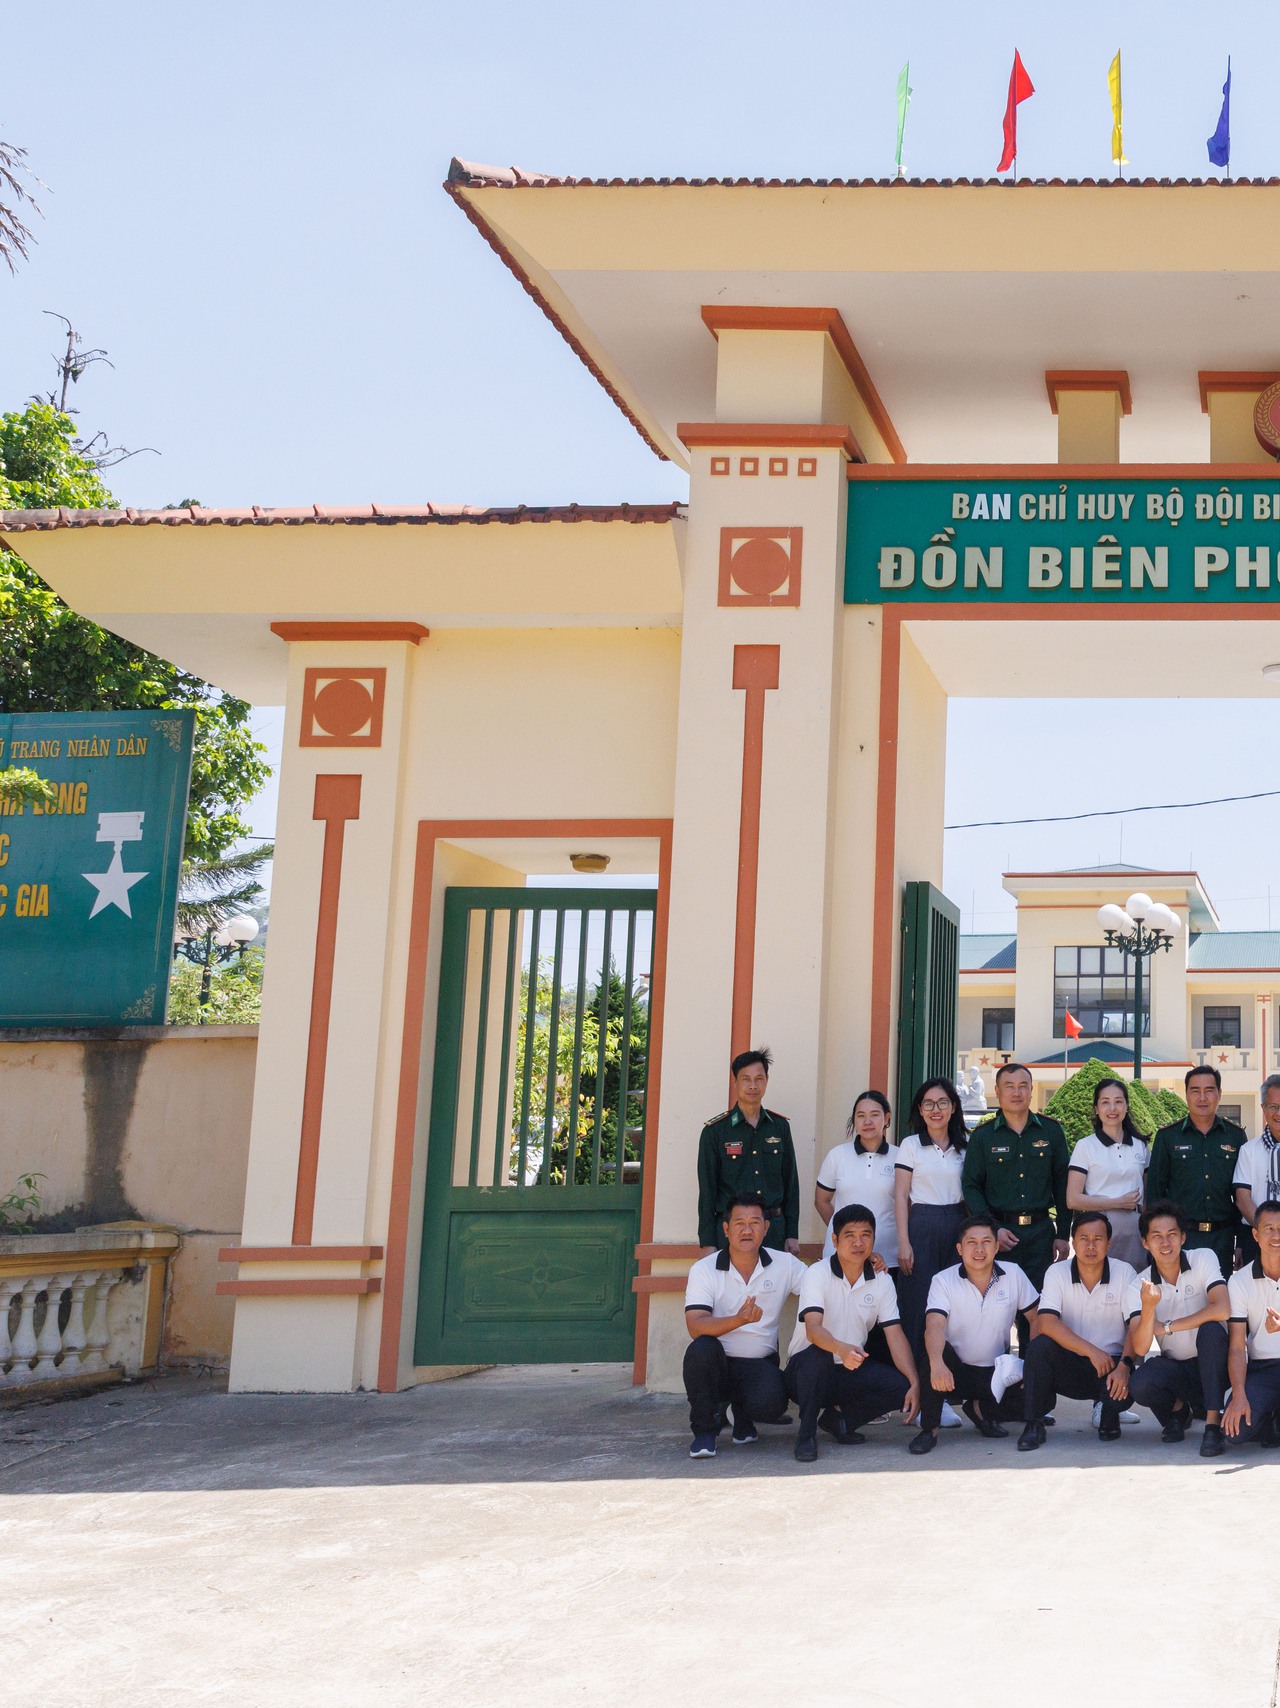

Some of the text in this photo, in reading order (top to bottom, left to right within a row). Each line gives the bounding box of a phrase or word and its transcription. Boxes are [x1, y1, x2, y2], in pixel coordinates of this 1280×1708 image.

[951, 492, 1011, 521] BAN
[1018, 484, 1068, 521] CHỈ
[1077, 493, 1135, 521] HUY
[1146, 486, 1185, 527] BỘ
[1195, 486, 1243, 527] ĐỘI
[878, 527, 1004, 590] ĐỒN
[1028, 534, 1169, 590] BIÊN
[11, 739, 60, 759] TRANG
[67, 734, 111, 757] NHÂN
[116, 733, 148, 756] DÂN
[15, 884, 49, 917] GIA
